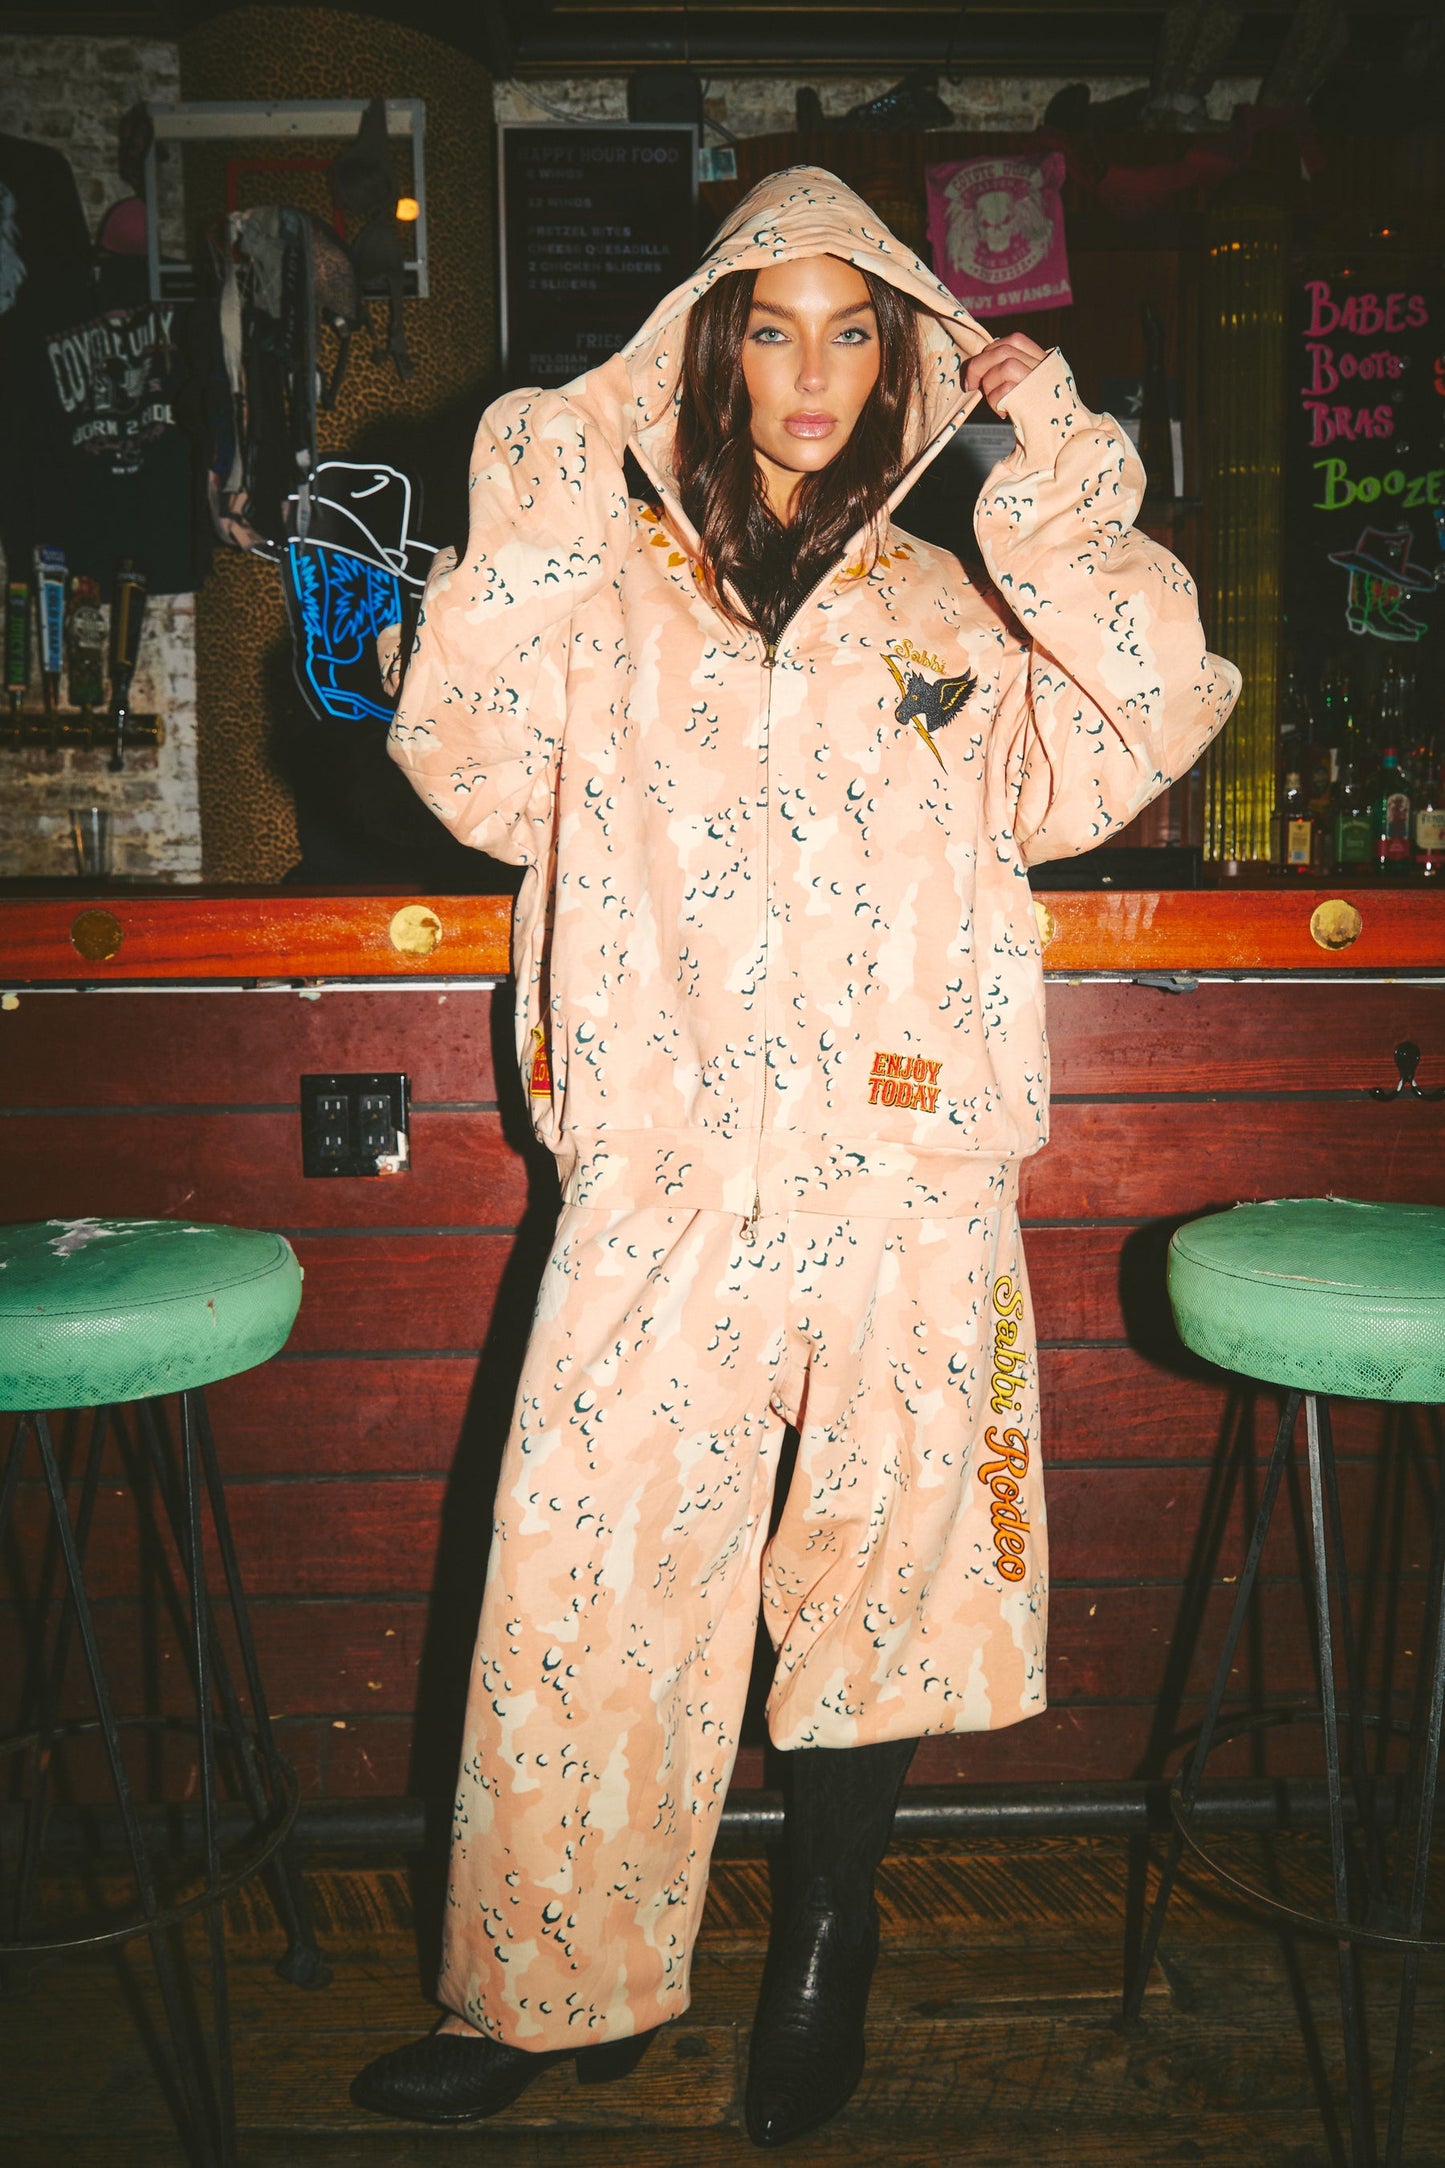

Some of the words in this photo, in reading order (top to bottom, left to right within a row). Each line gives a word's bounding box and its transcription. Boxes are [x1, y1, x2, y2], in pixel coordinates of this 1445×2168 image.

[519, 147, 574, 162] HAPPY
[581, 148, 626, 163] HOUR
[632, 148, 679, 163] FOOD
[539, 168, 584, 178] WINGS
[528, 198, 543, 208] 12
[547, 198, 593, 209] WINGS
[528, 226, 588, 237] PRETZEL
[591, 226, 632, 237] BITES
[528, 244, 582, 255] CHEESE
[585, 244, 670, 255] QUESADILLA
[528, 262, 537, 272] 2
[540, 262, 602, 272] CHICKEN
[605, 262, 662, 272] SLIDERS
[540, 280, 597, 289] SLIDERS
[1302, 280, 1429, 337] BABES
[576, 332, 623, 349] FRIES
[1301, 342, 1401, 396] BOOTS
[1302, 400, 1394, 447] BRAS
[1312, 457, 1445, 510] BOOZE
[893, 638, 947, 676] Sabbi
[870, 1051, 943, 1085] ENJOY
[868, 1076, 942, 1114] TODAY
[992, 1275, 1029, 1415] Sabbi
[977, 1425, 1031, 1583] Rodeo
